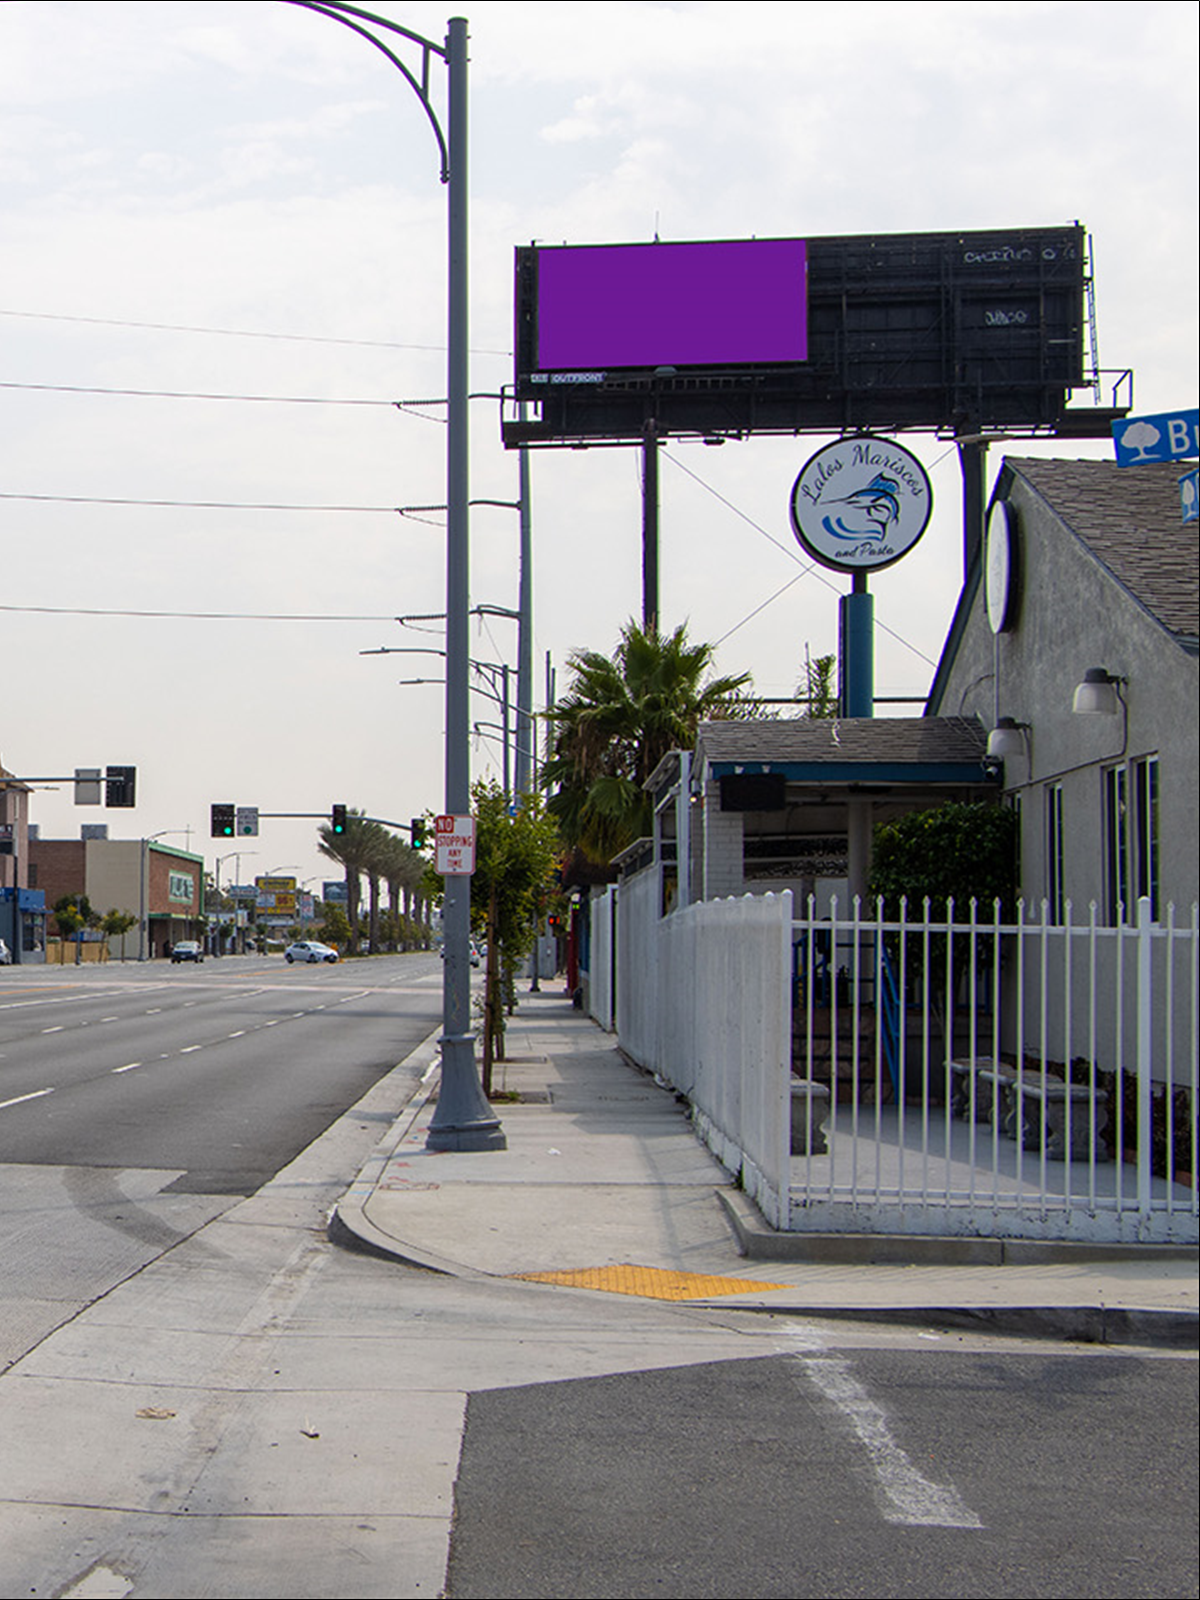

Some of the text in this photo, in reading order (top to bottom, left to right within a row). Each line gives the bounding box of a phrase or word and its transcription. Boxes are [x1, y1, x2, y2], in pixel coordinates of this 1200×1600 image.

[801, 444, 923, 506] Lalos Mariscos
[834, 545, 860, 558] and
[437, 818, 453, 831] NO
[437, 835, 473, 847] STOPPING
[448, 849, 462, 857] ANY
[447, 860, 462, 868] TIME
